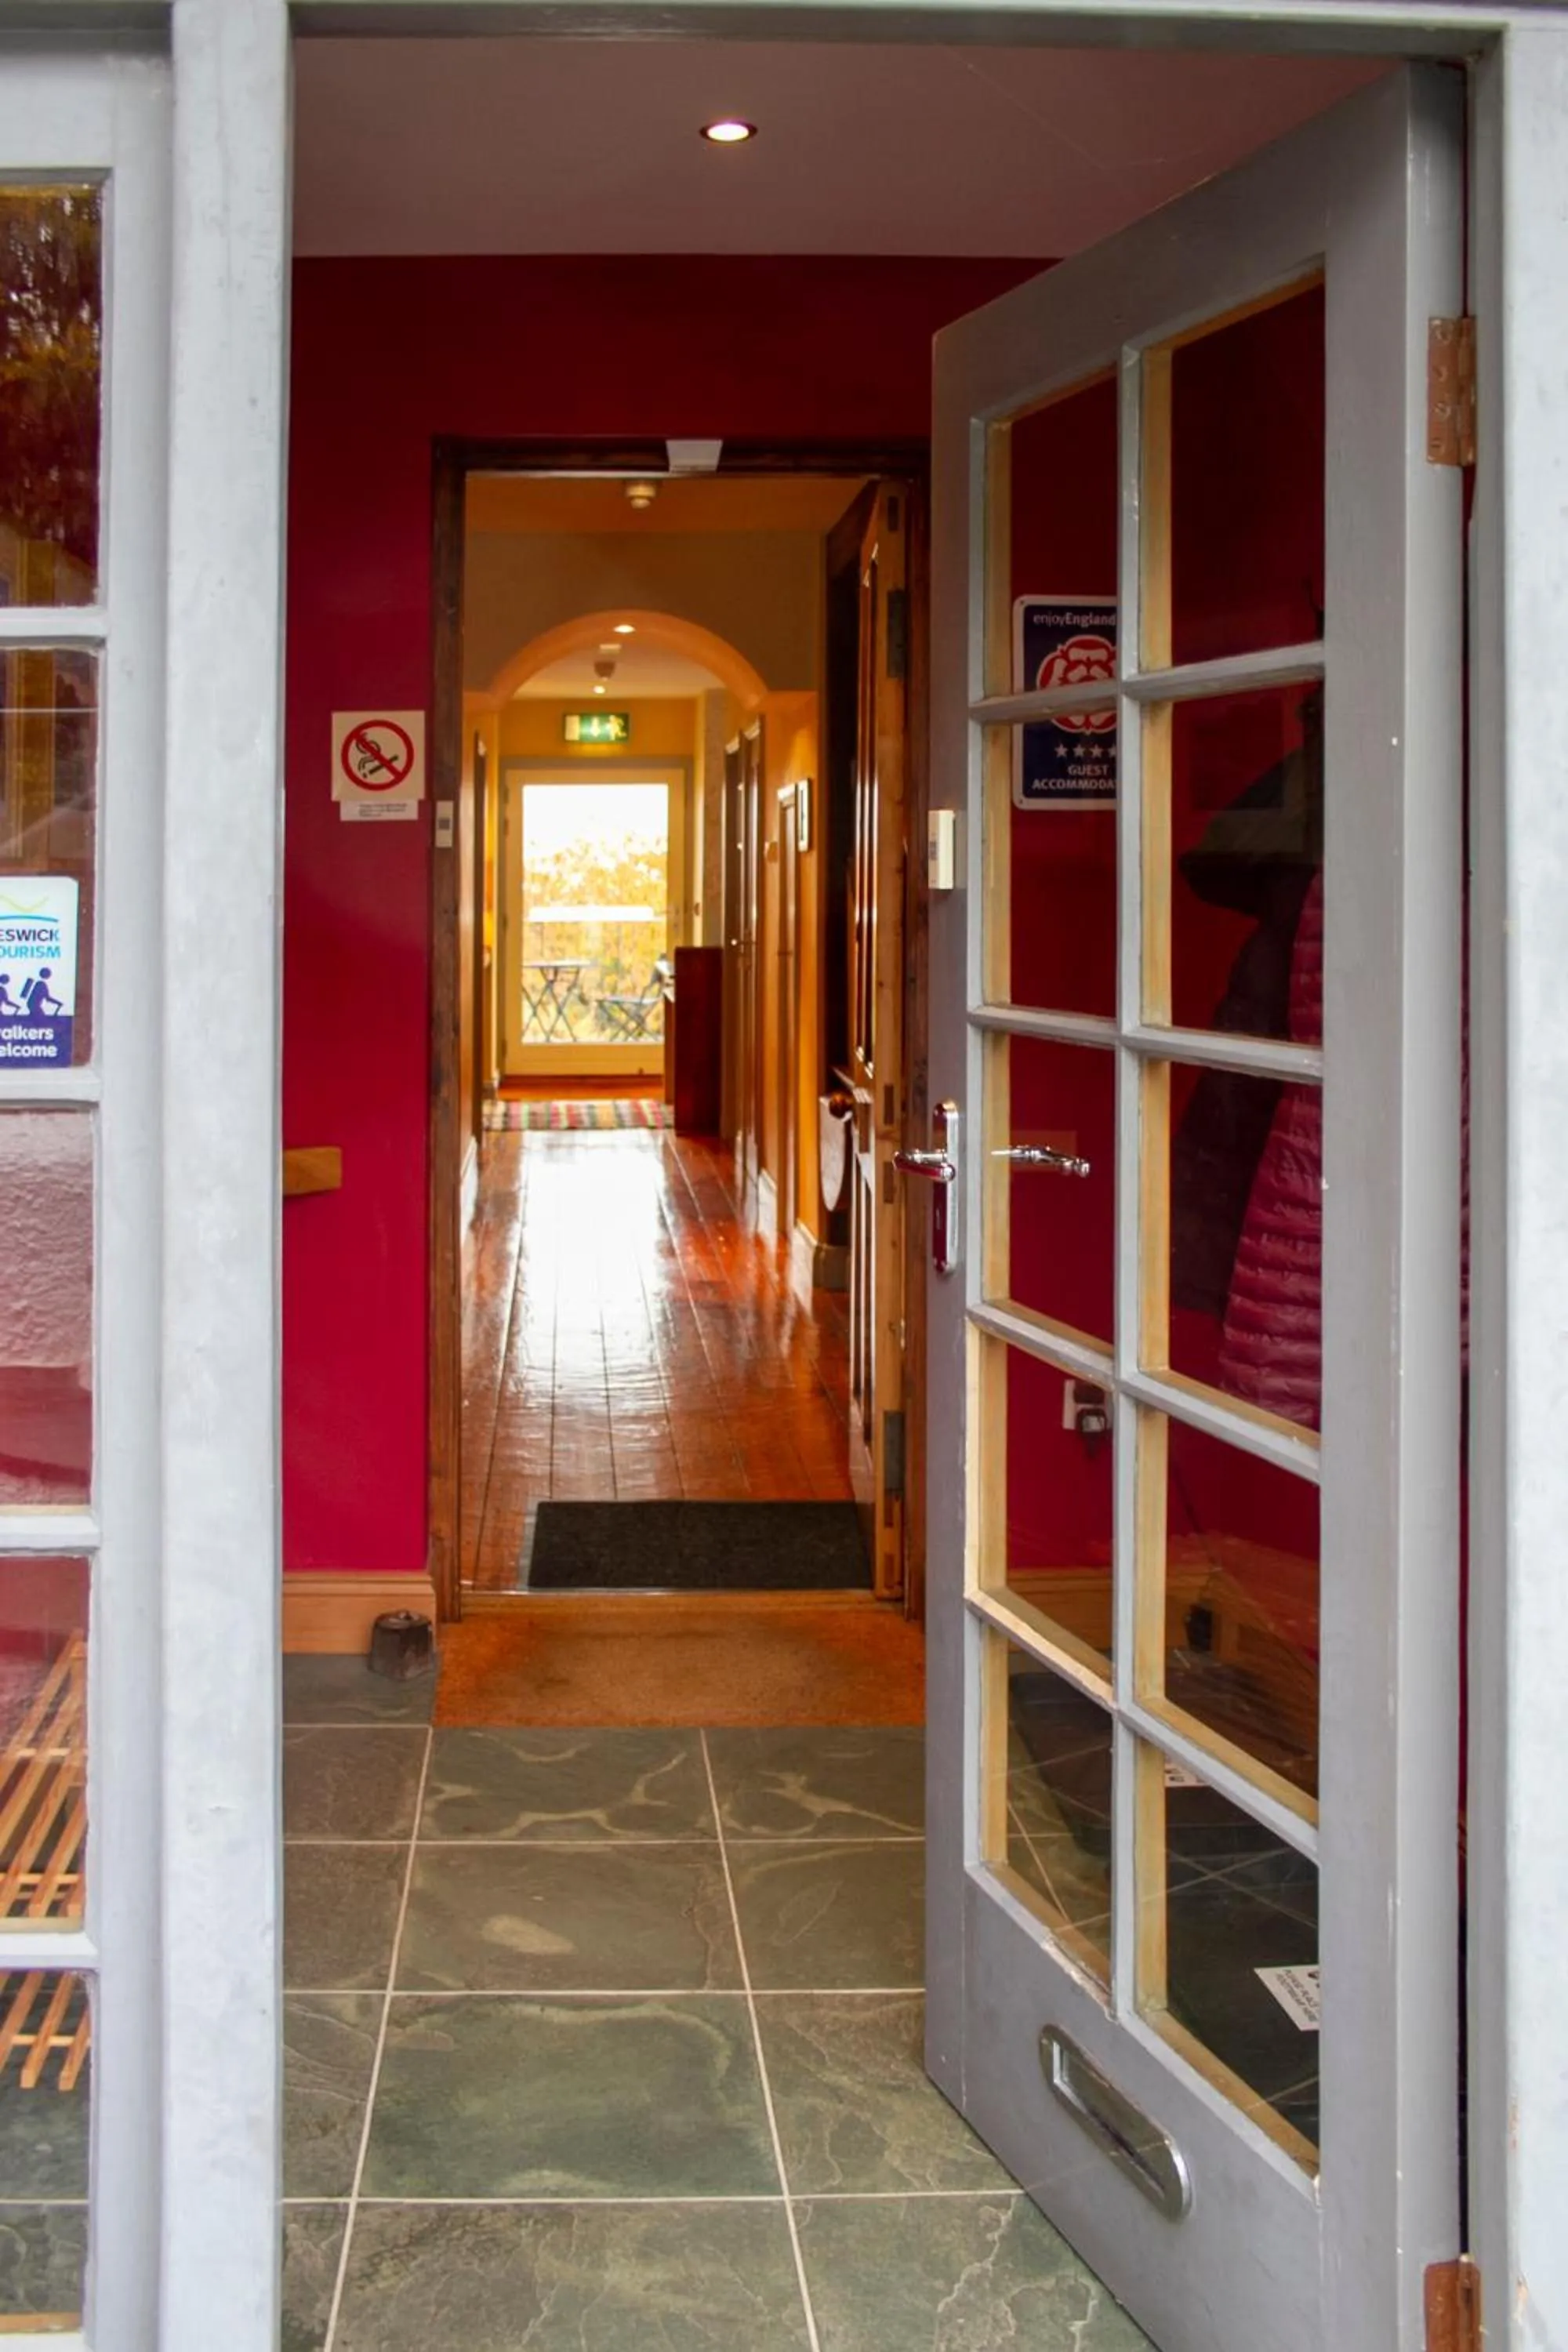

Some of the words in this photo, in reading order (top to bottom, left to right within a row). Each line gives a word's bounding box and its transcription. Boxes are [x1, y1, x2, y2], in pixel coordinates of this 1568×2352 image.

[1067, 764, 1109, 776] GUEST
[1032, 779, 1116, 790] ACCOMMODA
[0, 929, 60, 942] ESWICK
[0, 945, 61, 958] OURISM
[0, 1025, 54, 1040] alkers
[0, 1042, 58, 1058] elcome
